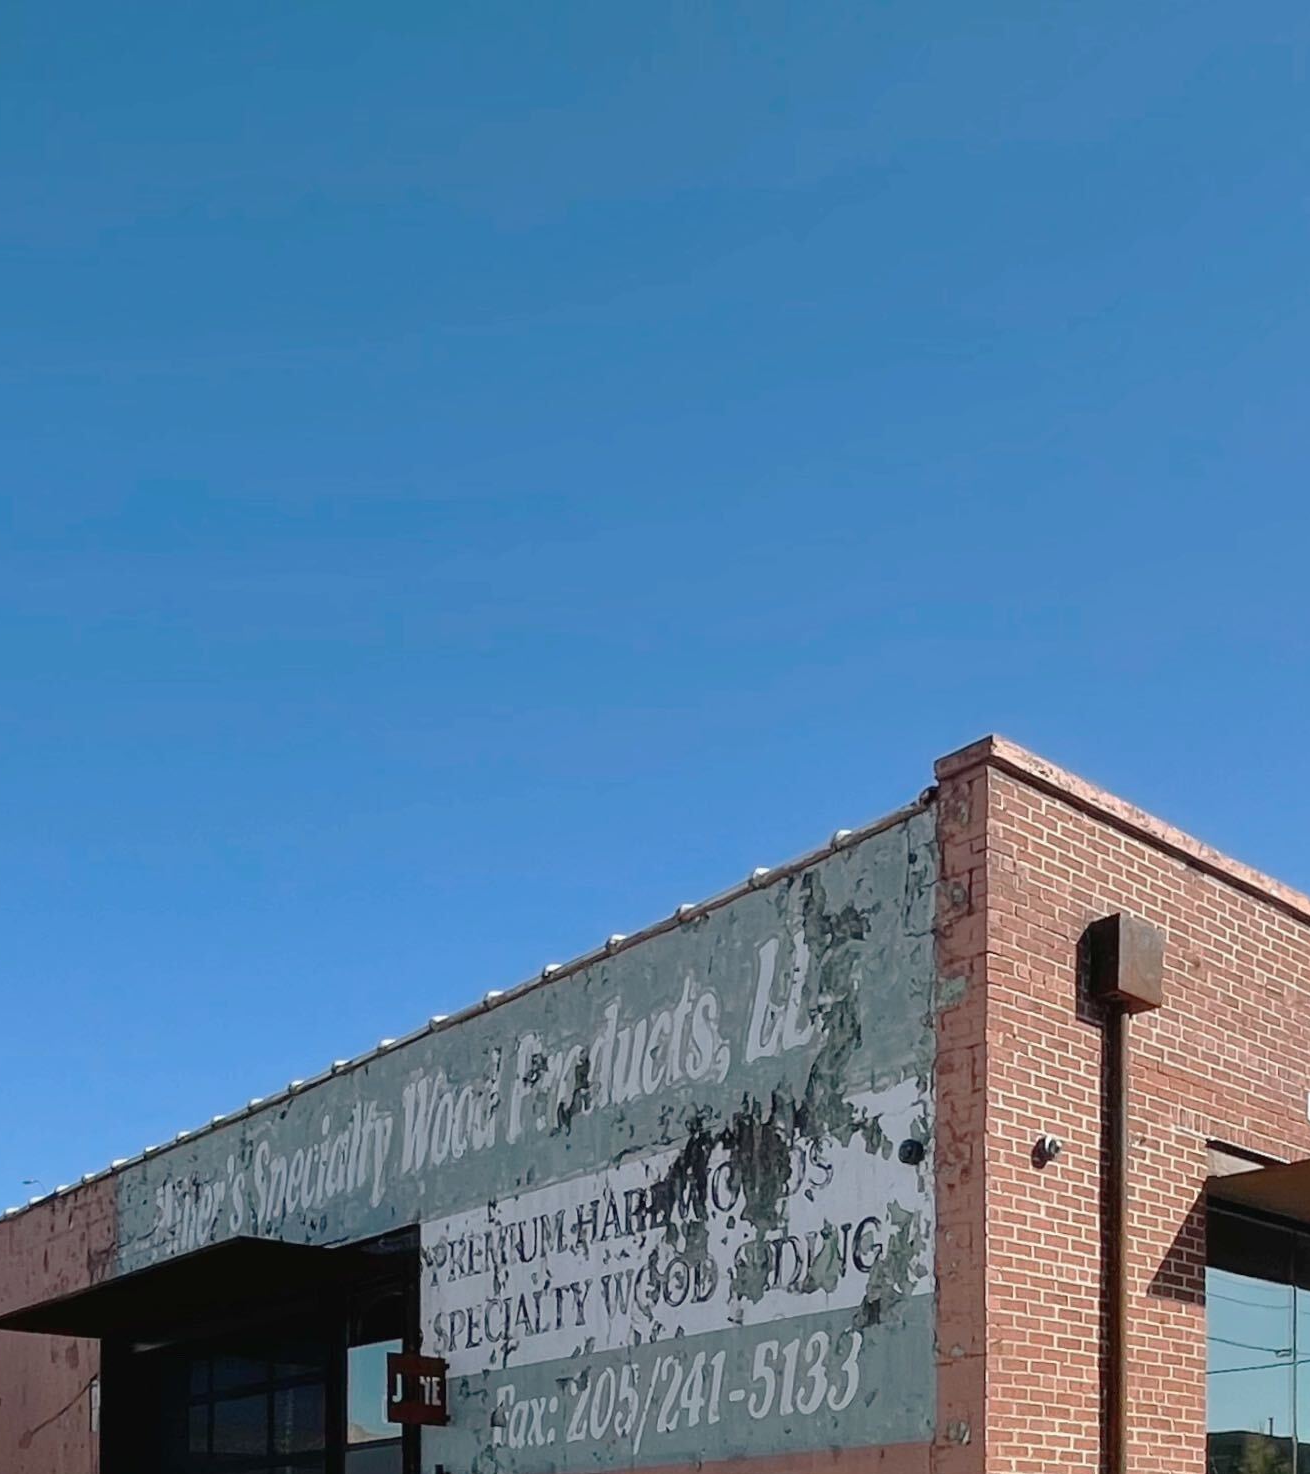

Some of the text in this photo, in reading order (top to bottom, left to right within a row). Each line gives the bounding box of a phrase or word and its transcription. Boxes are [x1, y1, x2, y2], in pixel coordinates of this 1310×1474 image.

[252, 1103, 392, 1232] Specialty
[400, 1044, 501, 1174] Wood
[424, 1208, 569, 1287] PREMIUM
[432, 1278, 593, 1353] SPECIALTY
[493, 1328, 864, 1455] Fax: 205/241-5133
